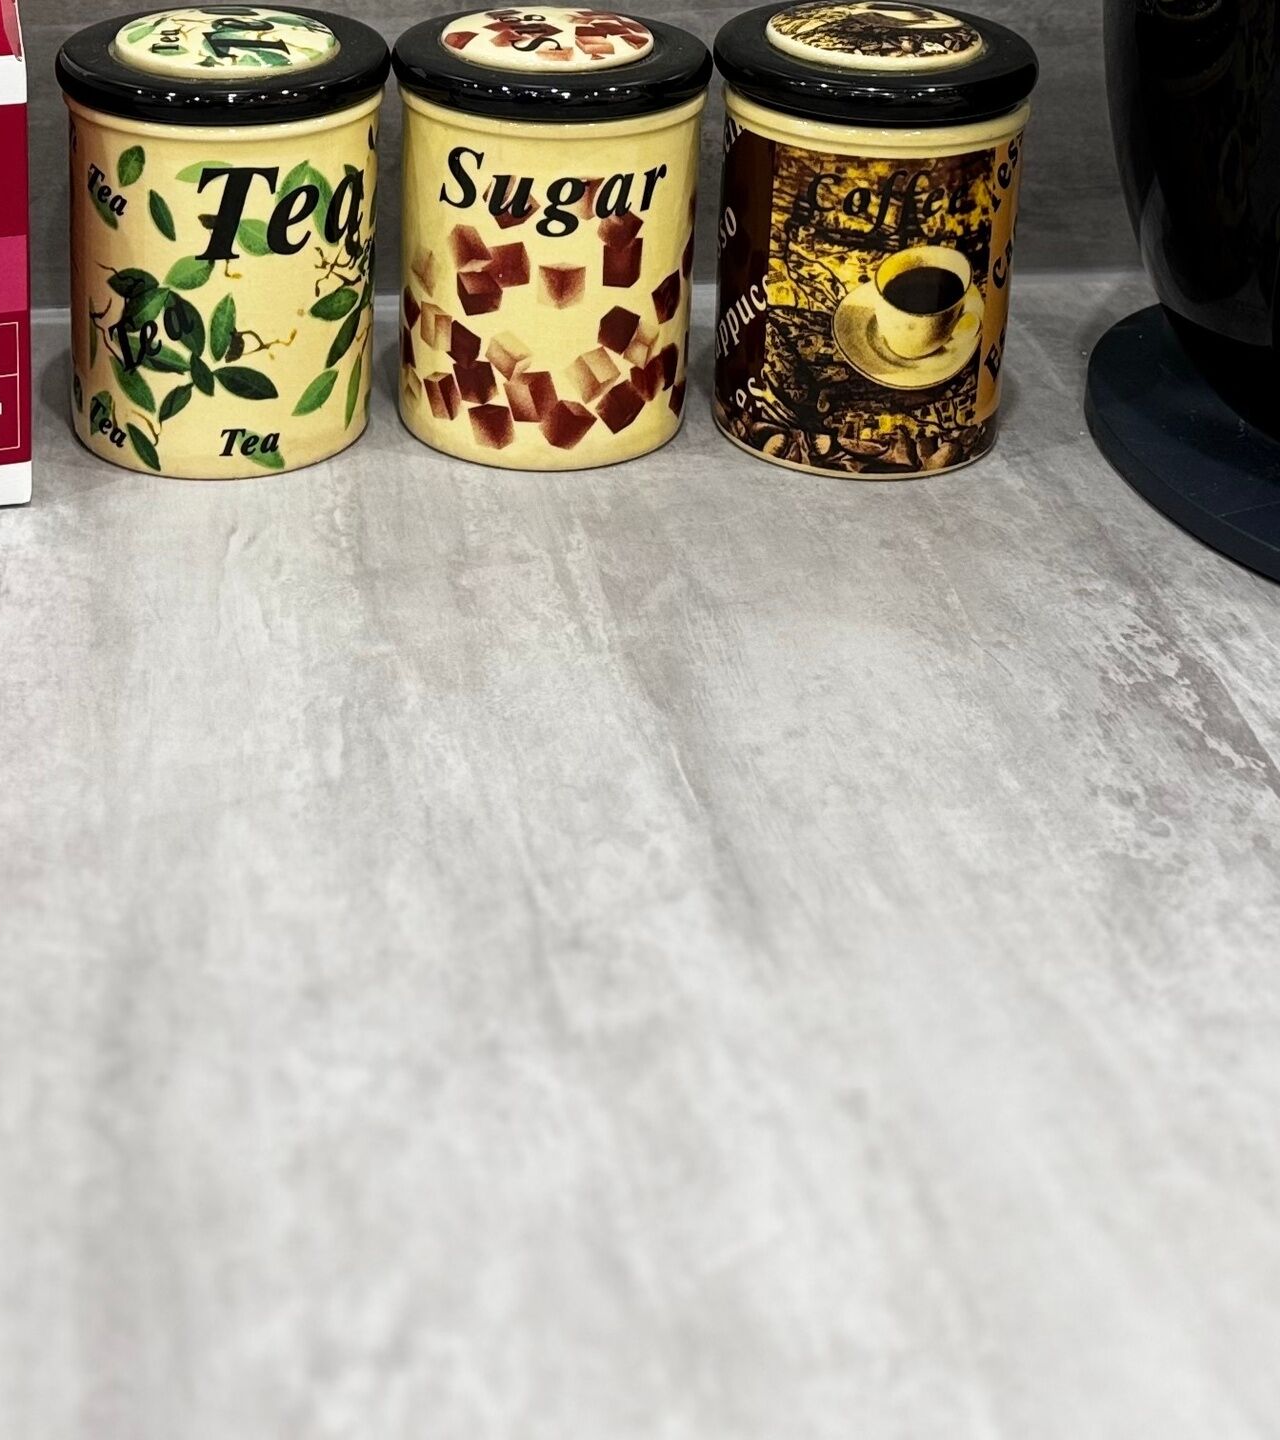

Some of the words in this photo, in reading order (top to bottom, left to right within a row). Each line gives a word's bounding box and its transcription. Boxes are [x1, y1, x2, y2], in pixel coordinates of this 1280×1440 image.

[87, 163, 128, 216] Tea
[194, 166, 366, 262] Tea
[439, 146, 668, 238] Sugar
[92, 396, 127, 449] Tea
[219, 428, 280, 457] Tea
